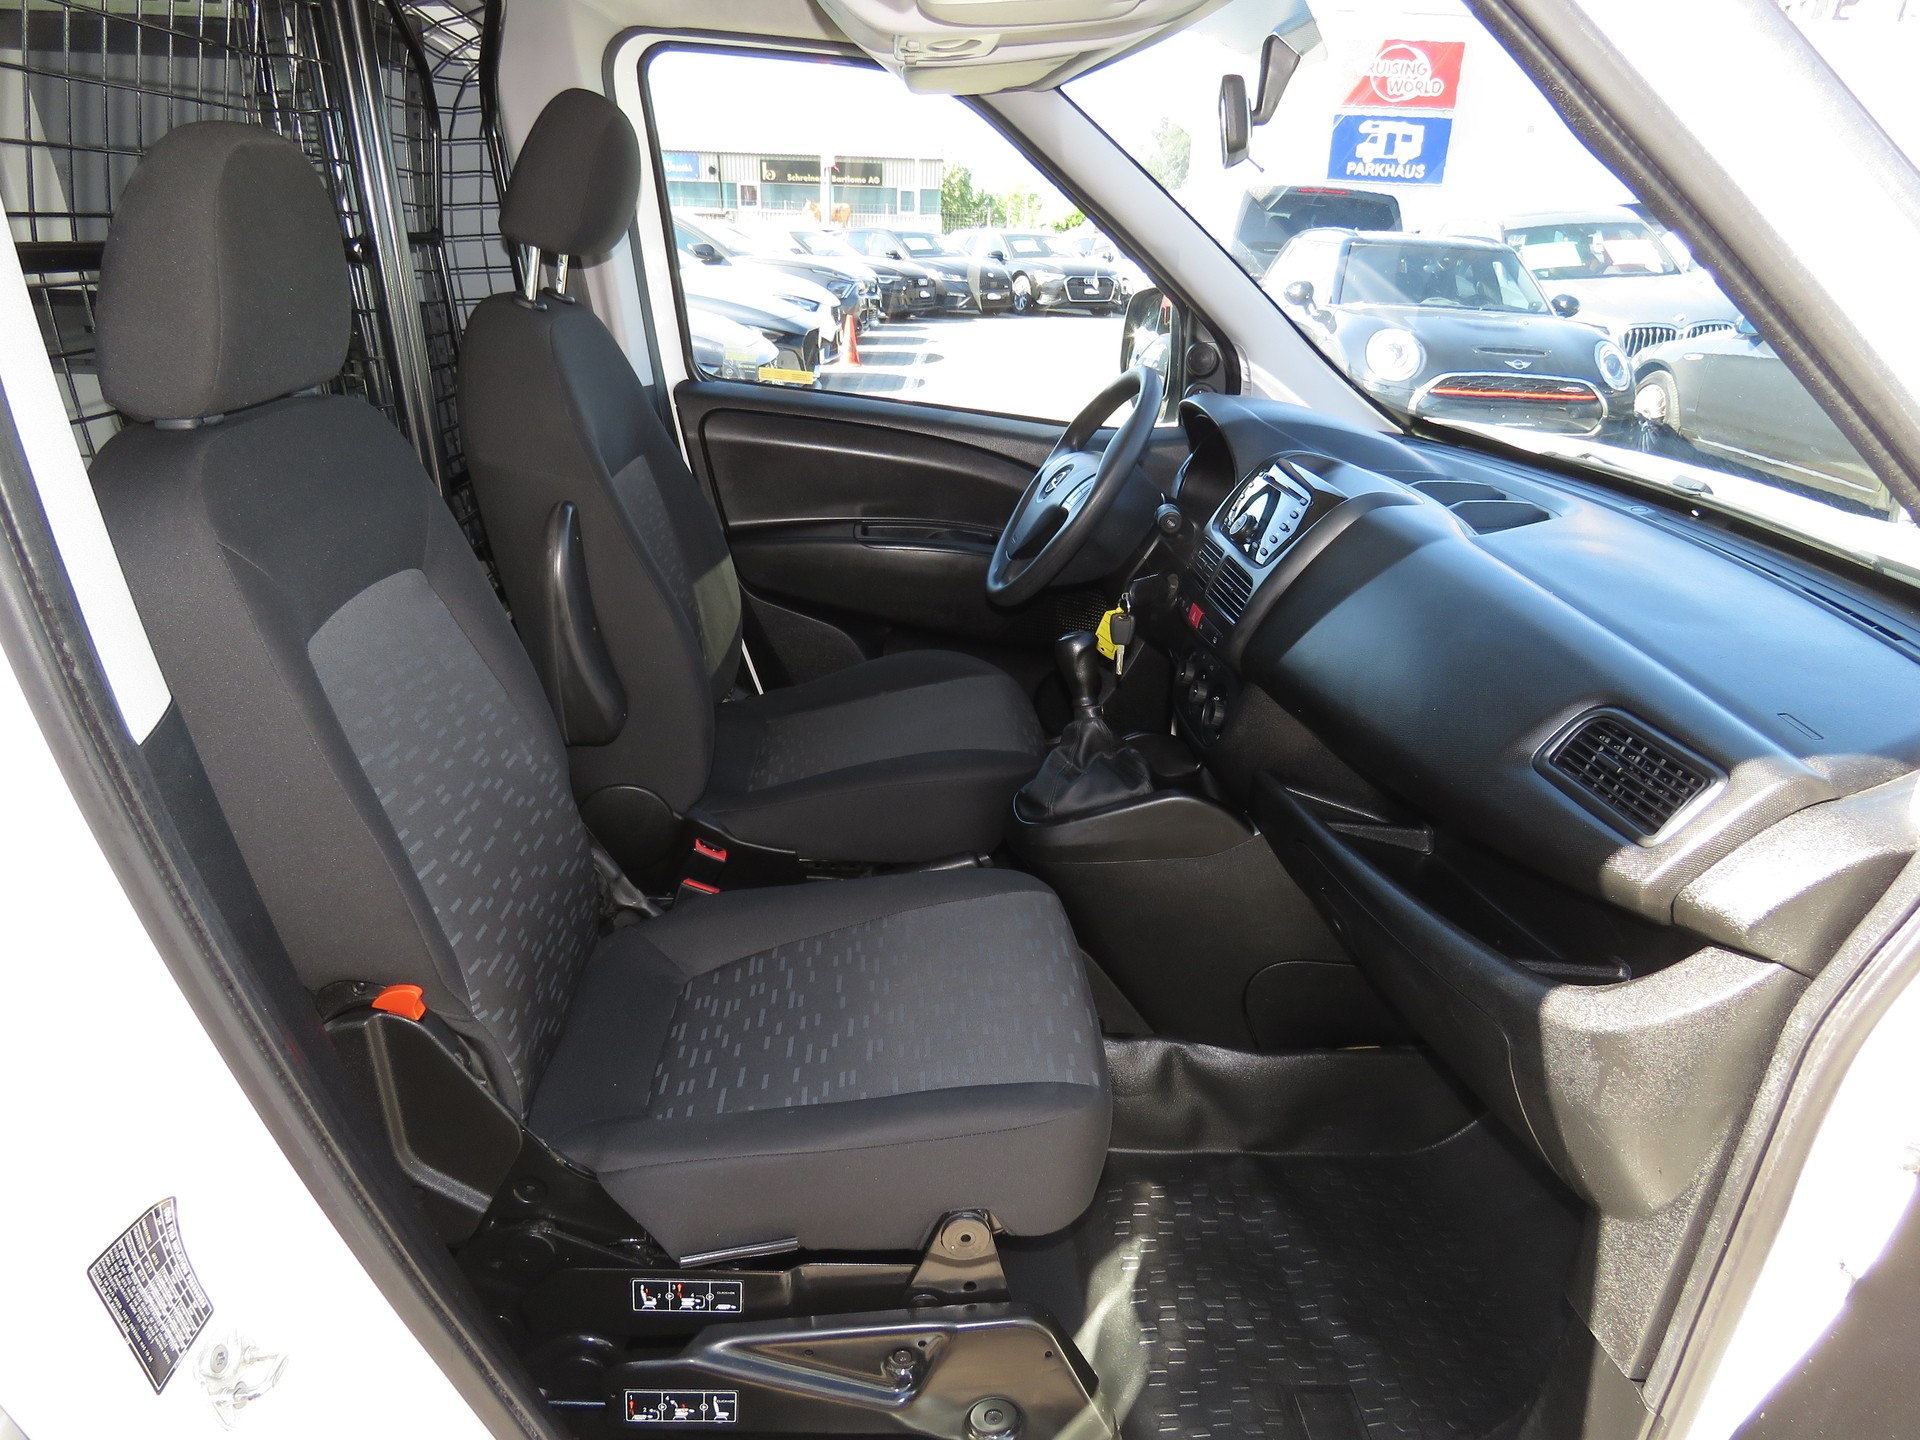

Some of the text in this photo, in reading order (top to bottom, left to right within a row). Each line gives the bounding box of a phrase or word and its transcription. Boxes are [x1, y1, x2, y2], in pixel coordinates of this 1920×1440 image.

[1367, 61, 1428, 76] RUISING
[1388, 80, 1442, 94] WORLD
[1346, 162, 1426, 178] PARKHAUS
[868, 175, 881, 184] AG
[185, 1272, 206, 1309] PRESSURES
